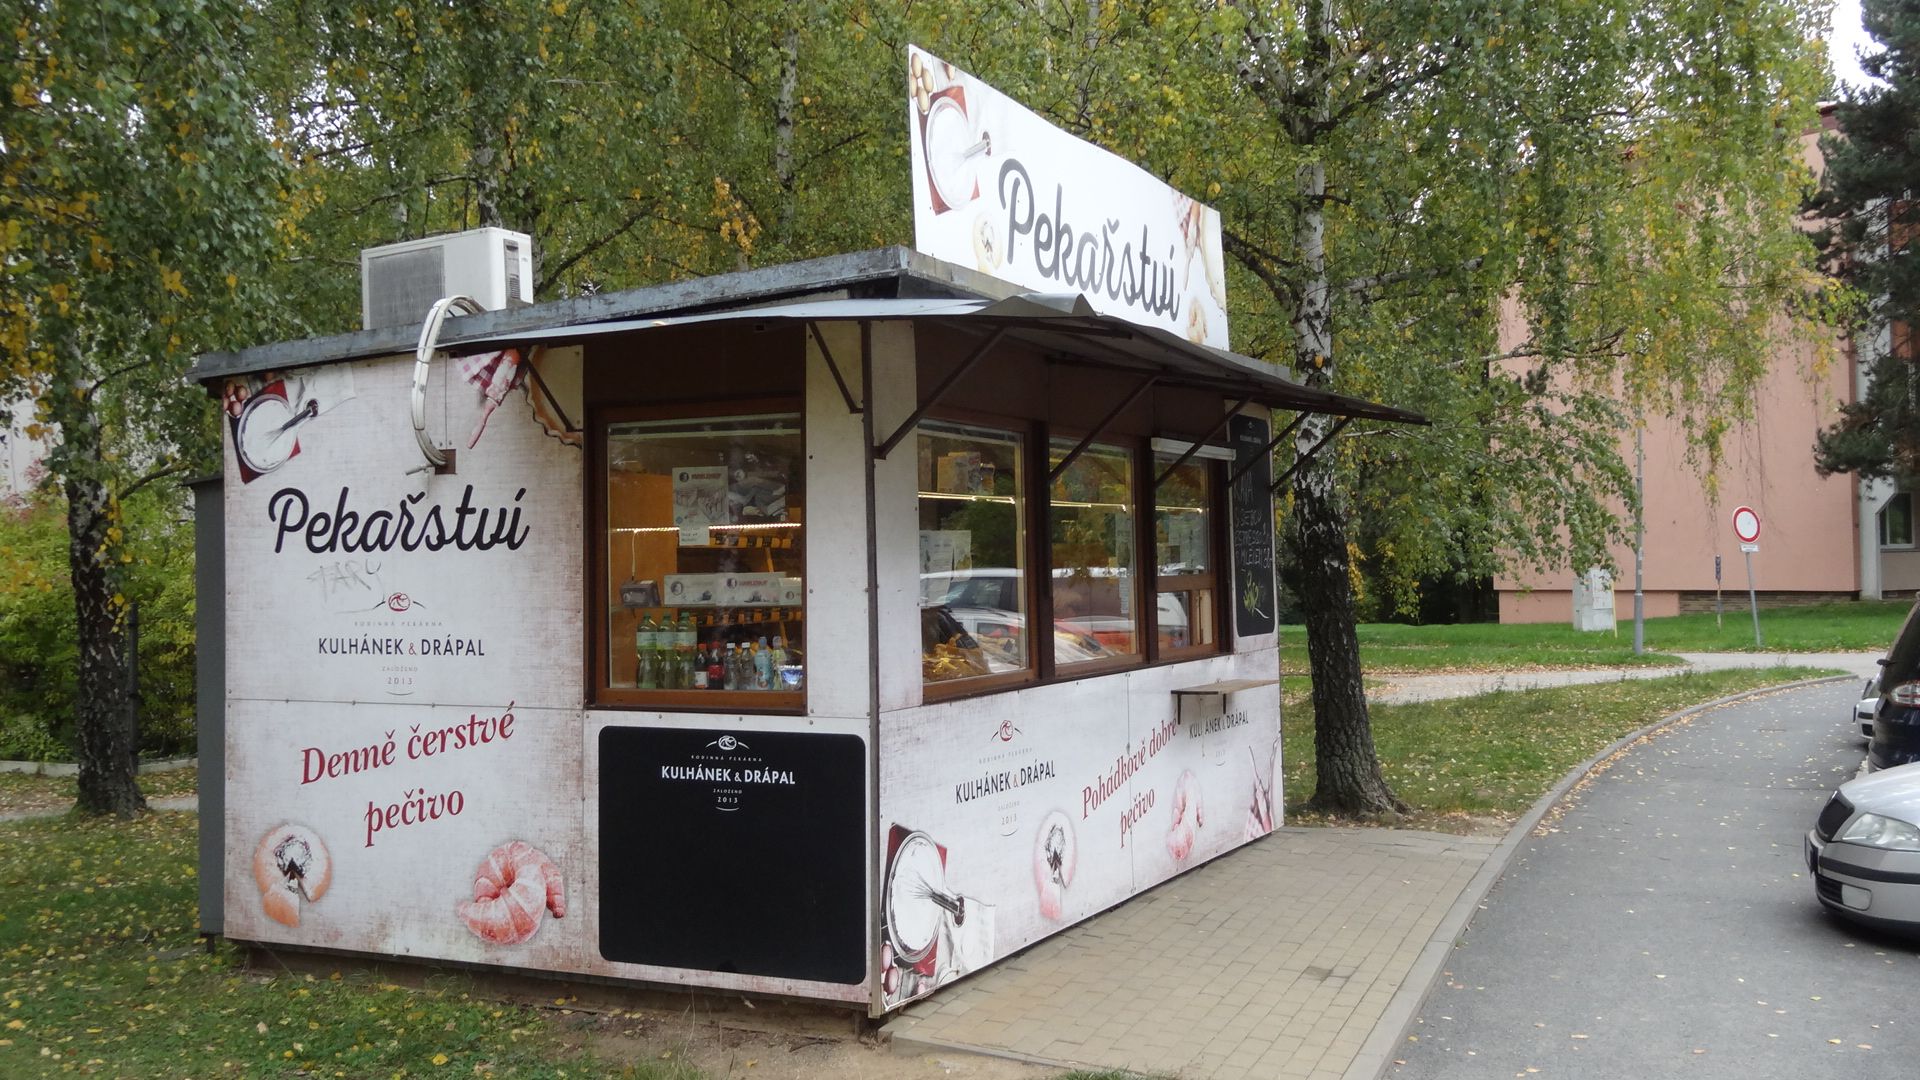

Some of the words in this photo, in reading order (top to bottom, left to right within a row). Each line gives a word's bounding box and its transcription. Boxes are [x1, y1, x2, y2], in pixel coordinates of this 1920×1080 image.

[998, 158, 1180, 322] Pekařství
[268, 484, 530, 554] Pekařství
[318, 633, 404, 655] KULHÁNEK
[408, 642, 417, 656] &
[421, 634, 485, 656] DRÁPAL
[387, 677, 413, 685] 2013
[1149, 708, 1177, 758] dobré
[1226, 708, 1249, 729] DRÁPAL
[300, 729, 396, 785] Denně
[407, 700, 515, 760] čerstvé
[661, 763, 731, 781] KULHÁNEK
[734, 772, 742, 782] &
[744, 766, 796, 784] DRÁPAL
[956, 771, 1011, 804] KULHÁNEK
[1013, 774, 1019, 787] &
[1020, 759, 1055, 786] DRÁPAL
[364, 788, 464, 848] pečivo
[717, 796, 738, 804] 2013
[1120, 788, 1155, 848] pečivo
